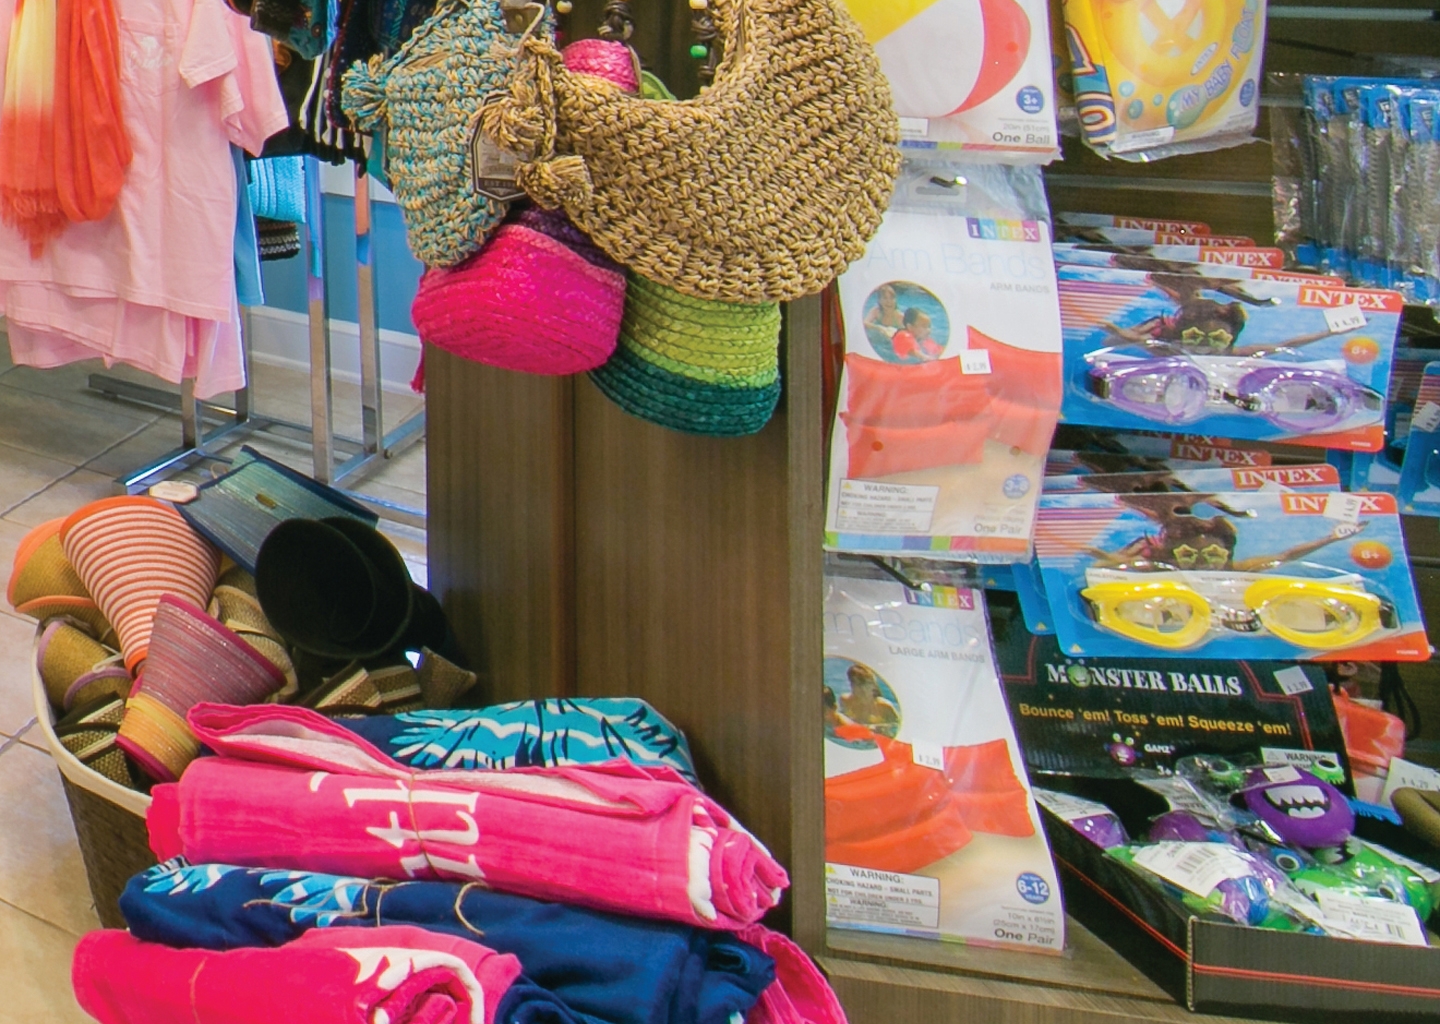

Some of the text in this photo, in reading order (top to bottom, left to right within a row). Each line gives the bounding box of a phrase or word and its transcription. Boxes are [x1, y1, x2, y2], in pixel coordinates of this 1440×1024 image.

[1022, 95, 1039, 106] 3+
[992, 131, 1050, 145] One Ball
[970, 222, 1038, 241] INTEX
[1120, 219, 1197, 235] INTEX
[867, 242, 1047, 281] Arm Bands
[1203, 250, 1273, 267] INTEX
[1303, 288, 1388, 310] INTEX
[1176, 445, 1258, 465] INTEX
[1238, 468, 1323, 489] INTEX
[974, 523, 1023, 534] One Pair
[908, 589, 972, 608] INTEX
[888, 645, 986, 664] LARGE ARM BANDS
[1168, 671, 1243, 696] BALLS
[1019, 703, 1075, 720] Bounce
[1116, 710, 1149, 725] Toss
[1188, 715, 1255, 734] Squeeze
[850, 868, 904, 884] WARNING:
[1017, 879, 1049, 897] 6-12
[994, 928, 1056, 946] One Pair
